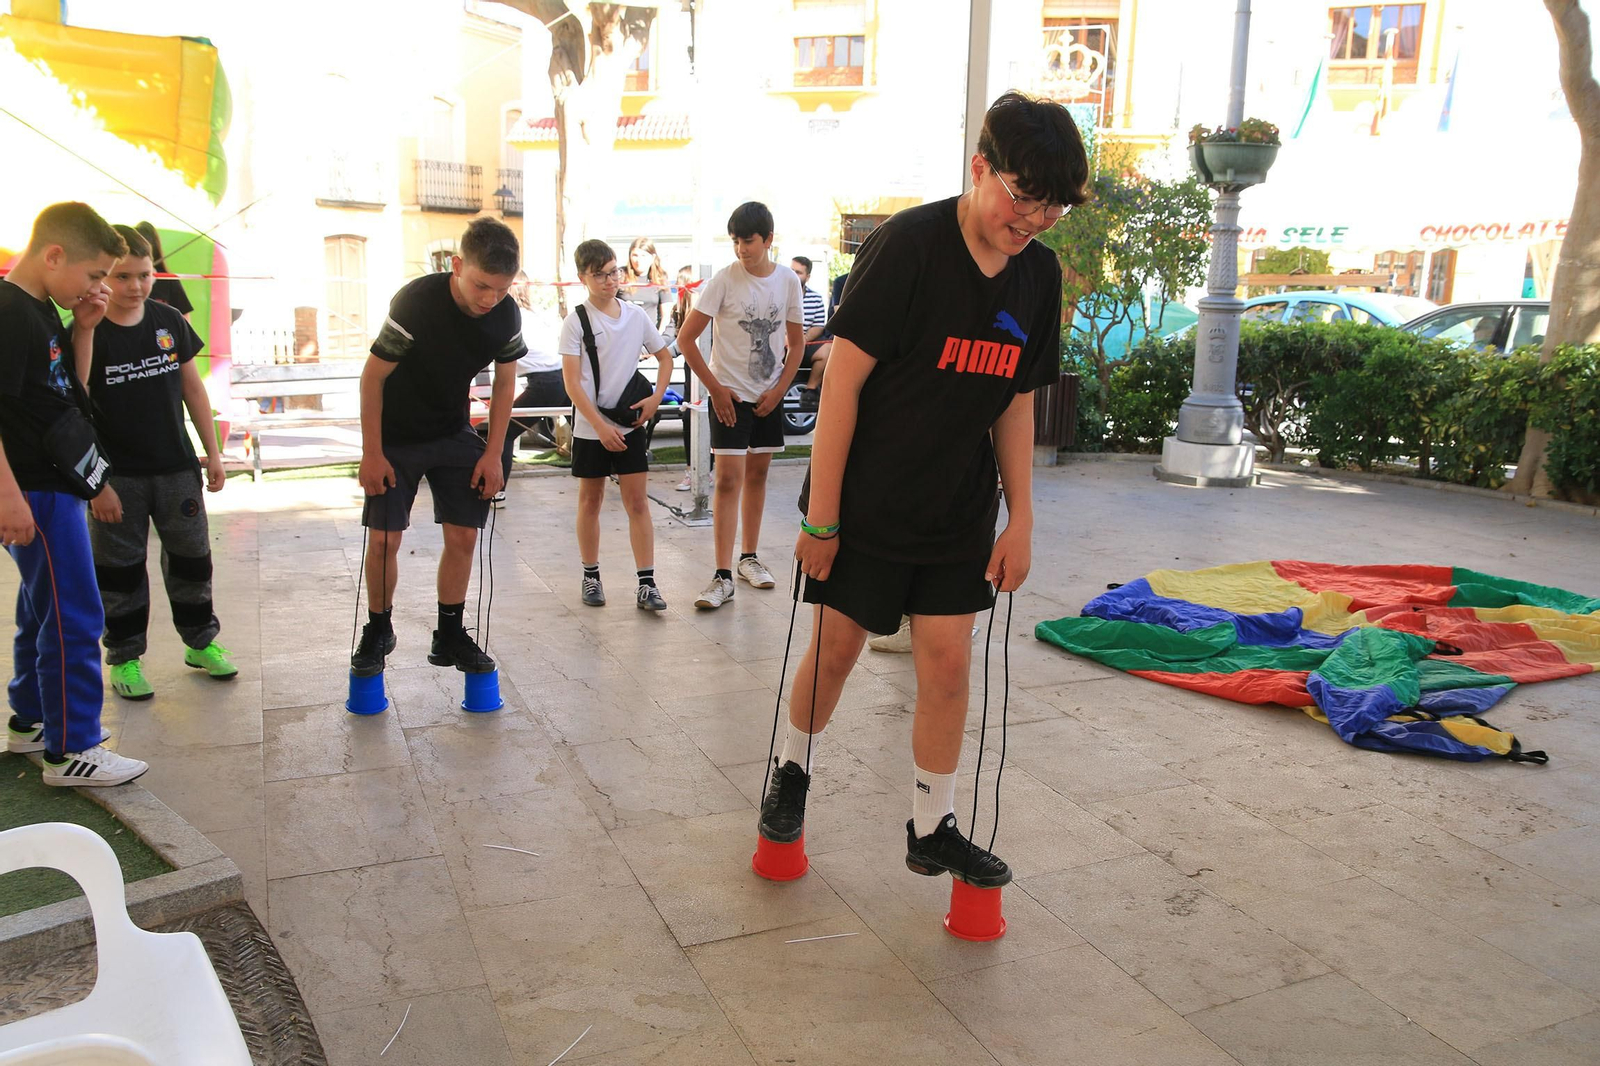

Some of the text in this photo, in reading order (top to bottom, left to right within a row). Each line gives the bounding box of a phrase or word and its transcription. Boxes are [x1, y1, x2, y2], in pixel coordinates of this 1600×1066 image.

[1280, 227, 1349, 243] SELE
[105, 353, 171, 375] POLICIA
[937, 336, 1021, 379] PUMA
[106, 362, 180, 385] DE PAISANO
[86, 456, 110, 490] PUMA
